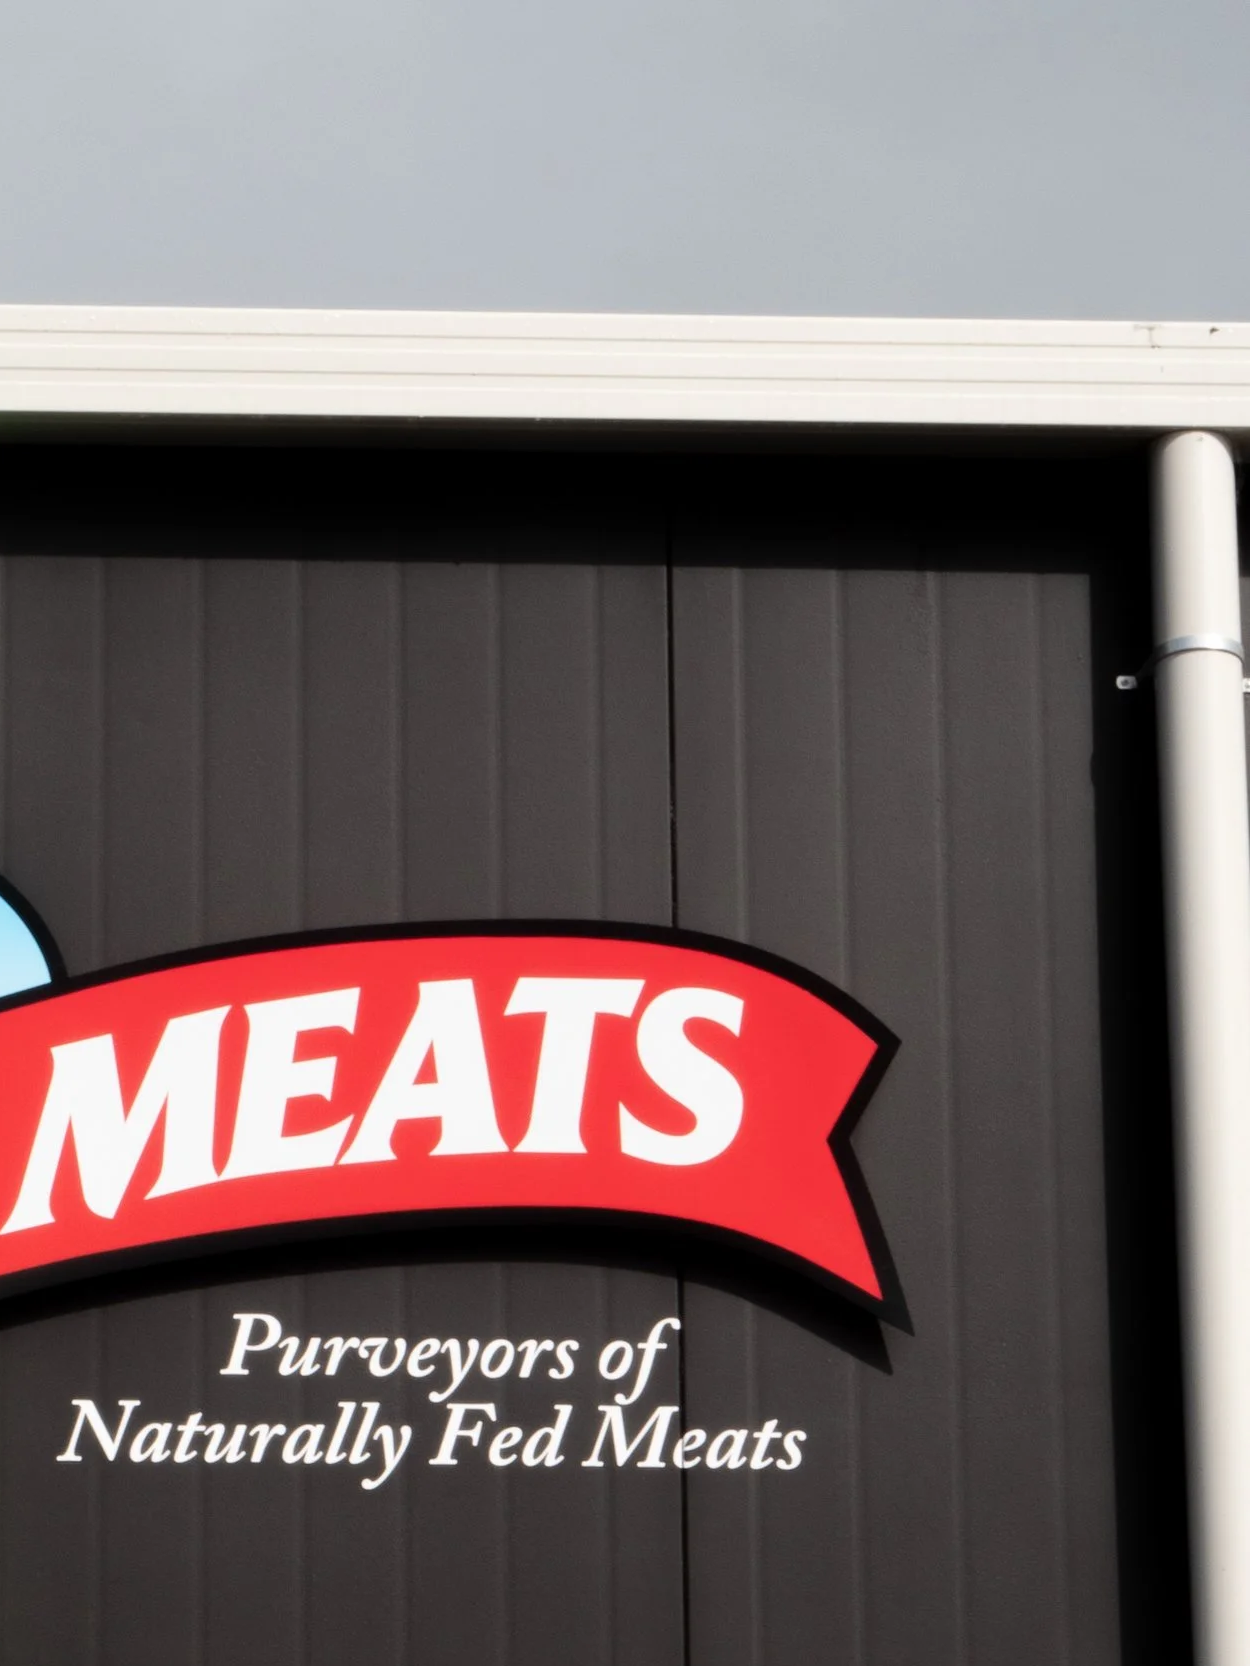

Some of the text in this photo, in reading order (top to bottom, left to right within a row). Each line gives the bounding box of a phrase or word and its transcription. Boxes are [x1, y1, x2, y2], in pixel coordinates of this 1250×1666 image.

[219, 1312, 682, 1407] Purveyors of
[55, 1398, 808, 1491] Naturally Fed Meats
